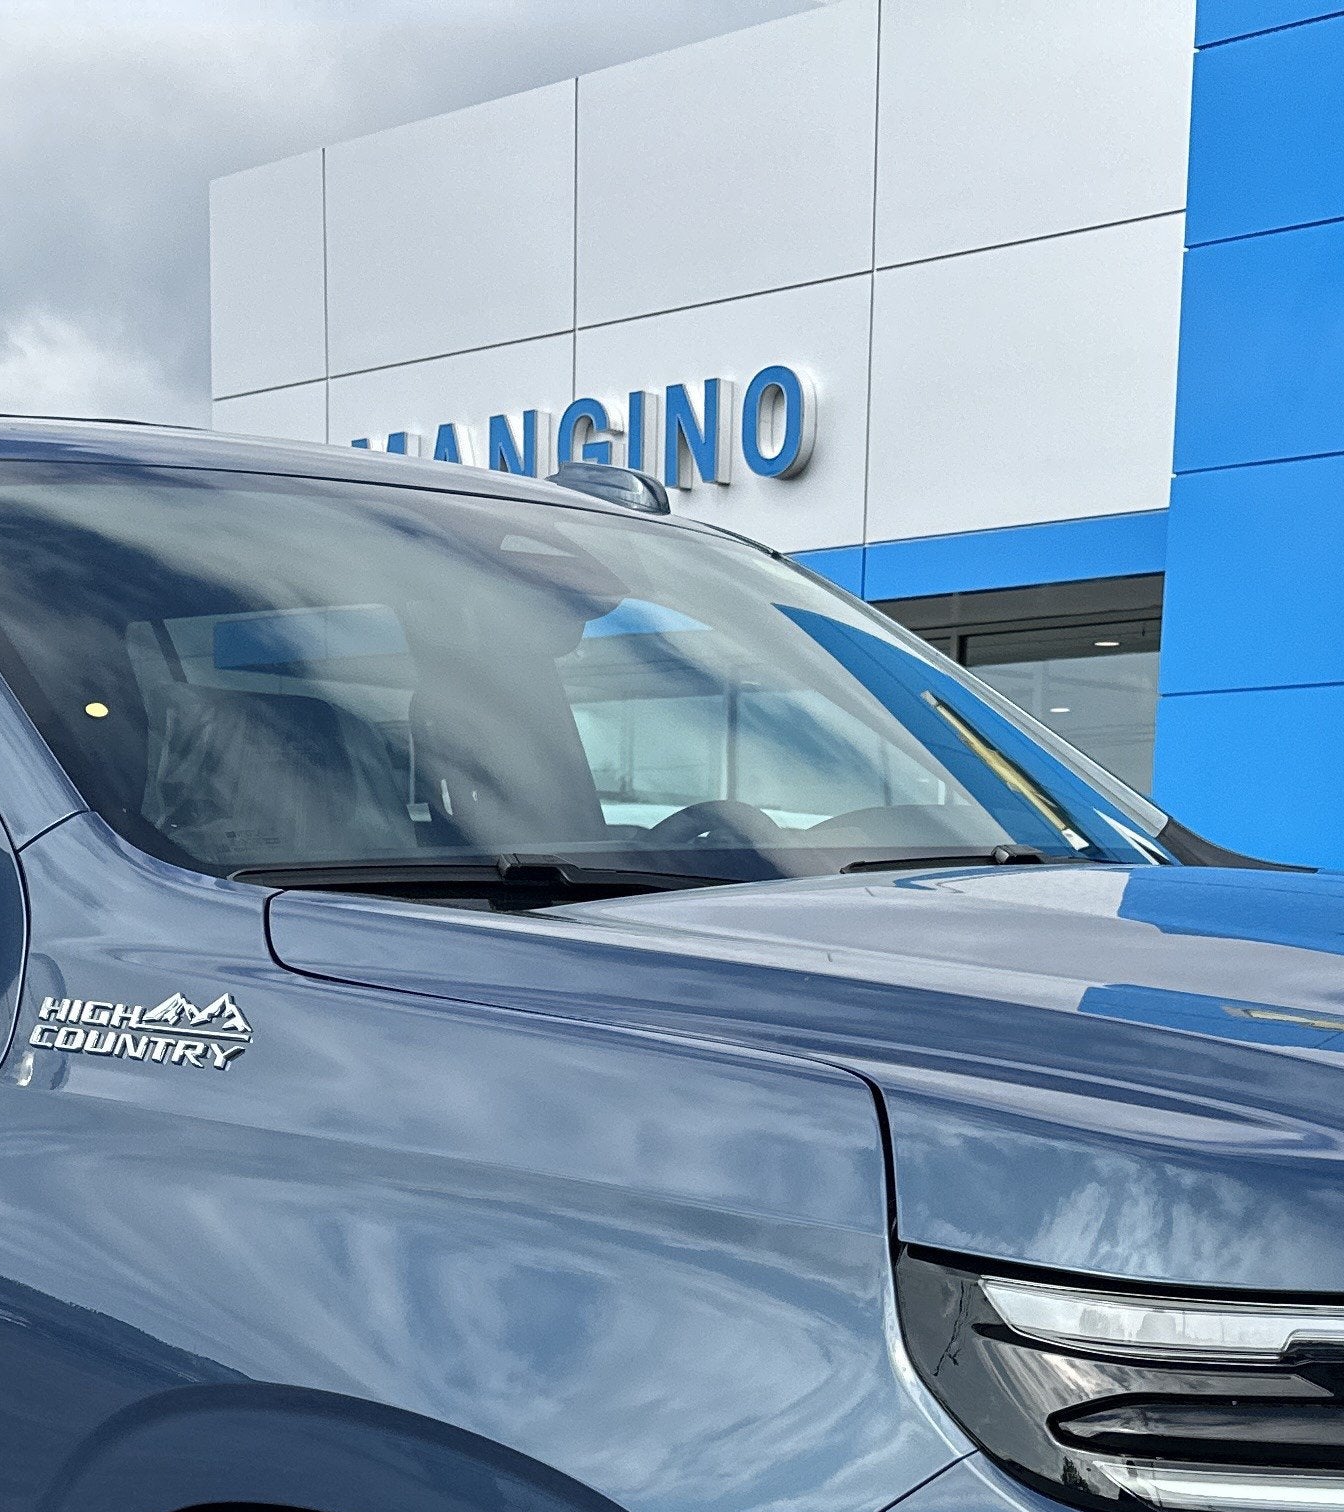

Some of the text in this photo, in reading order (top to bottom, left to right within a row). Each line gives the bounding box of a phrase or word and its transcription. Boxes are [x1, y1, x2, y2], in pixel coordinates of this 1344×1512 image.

[351, 364, 816, 491] NGINO
[38, 996, 145, 1030] HIGH
[29, 1024, 246, 1071] COUNTRY
